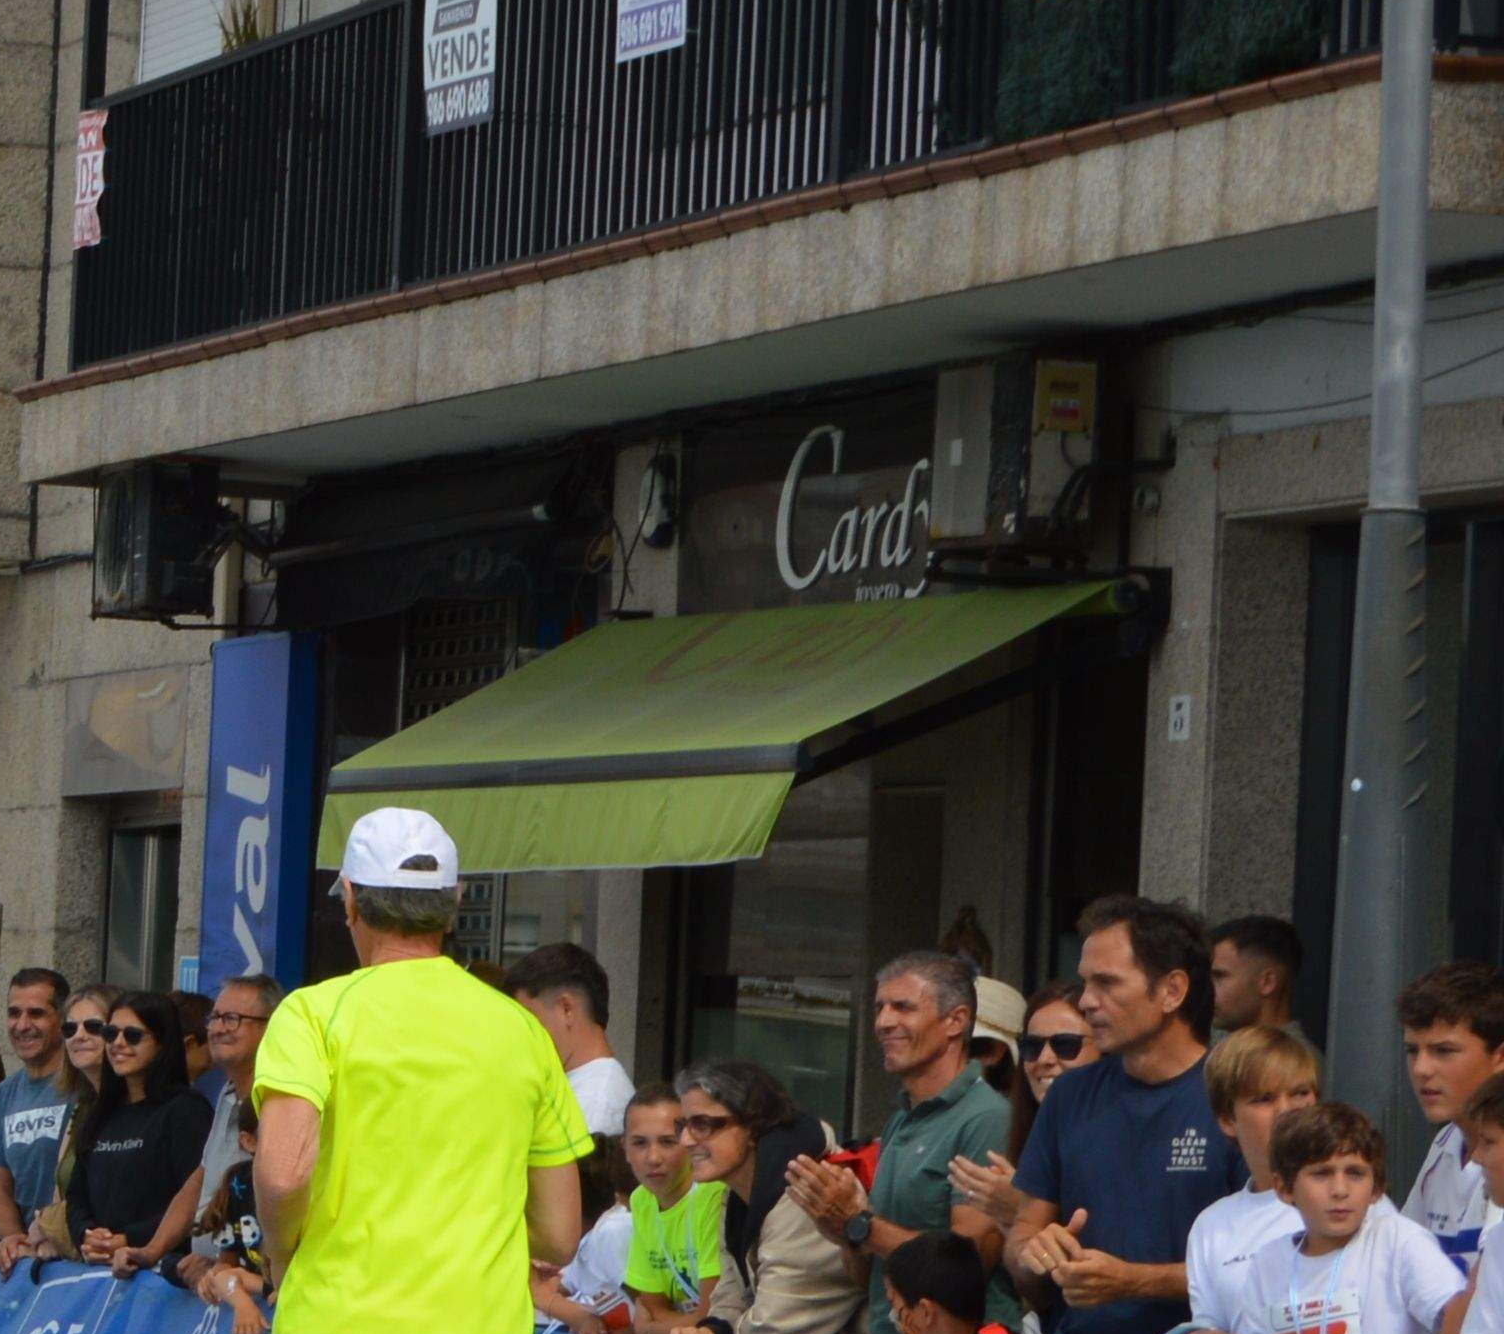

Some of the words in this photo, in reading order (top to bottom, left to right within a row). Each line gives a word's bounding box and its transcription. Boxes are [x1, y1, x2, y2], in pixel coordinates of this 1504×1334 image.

[428, 28, 490, 82] VENDE
[1171, 1137, 1207, 1147] OCEAN
[1171, 1156, 1204, 1165] TRUST
